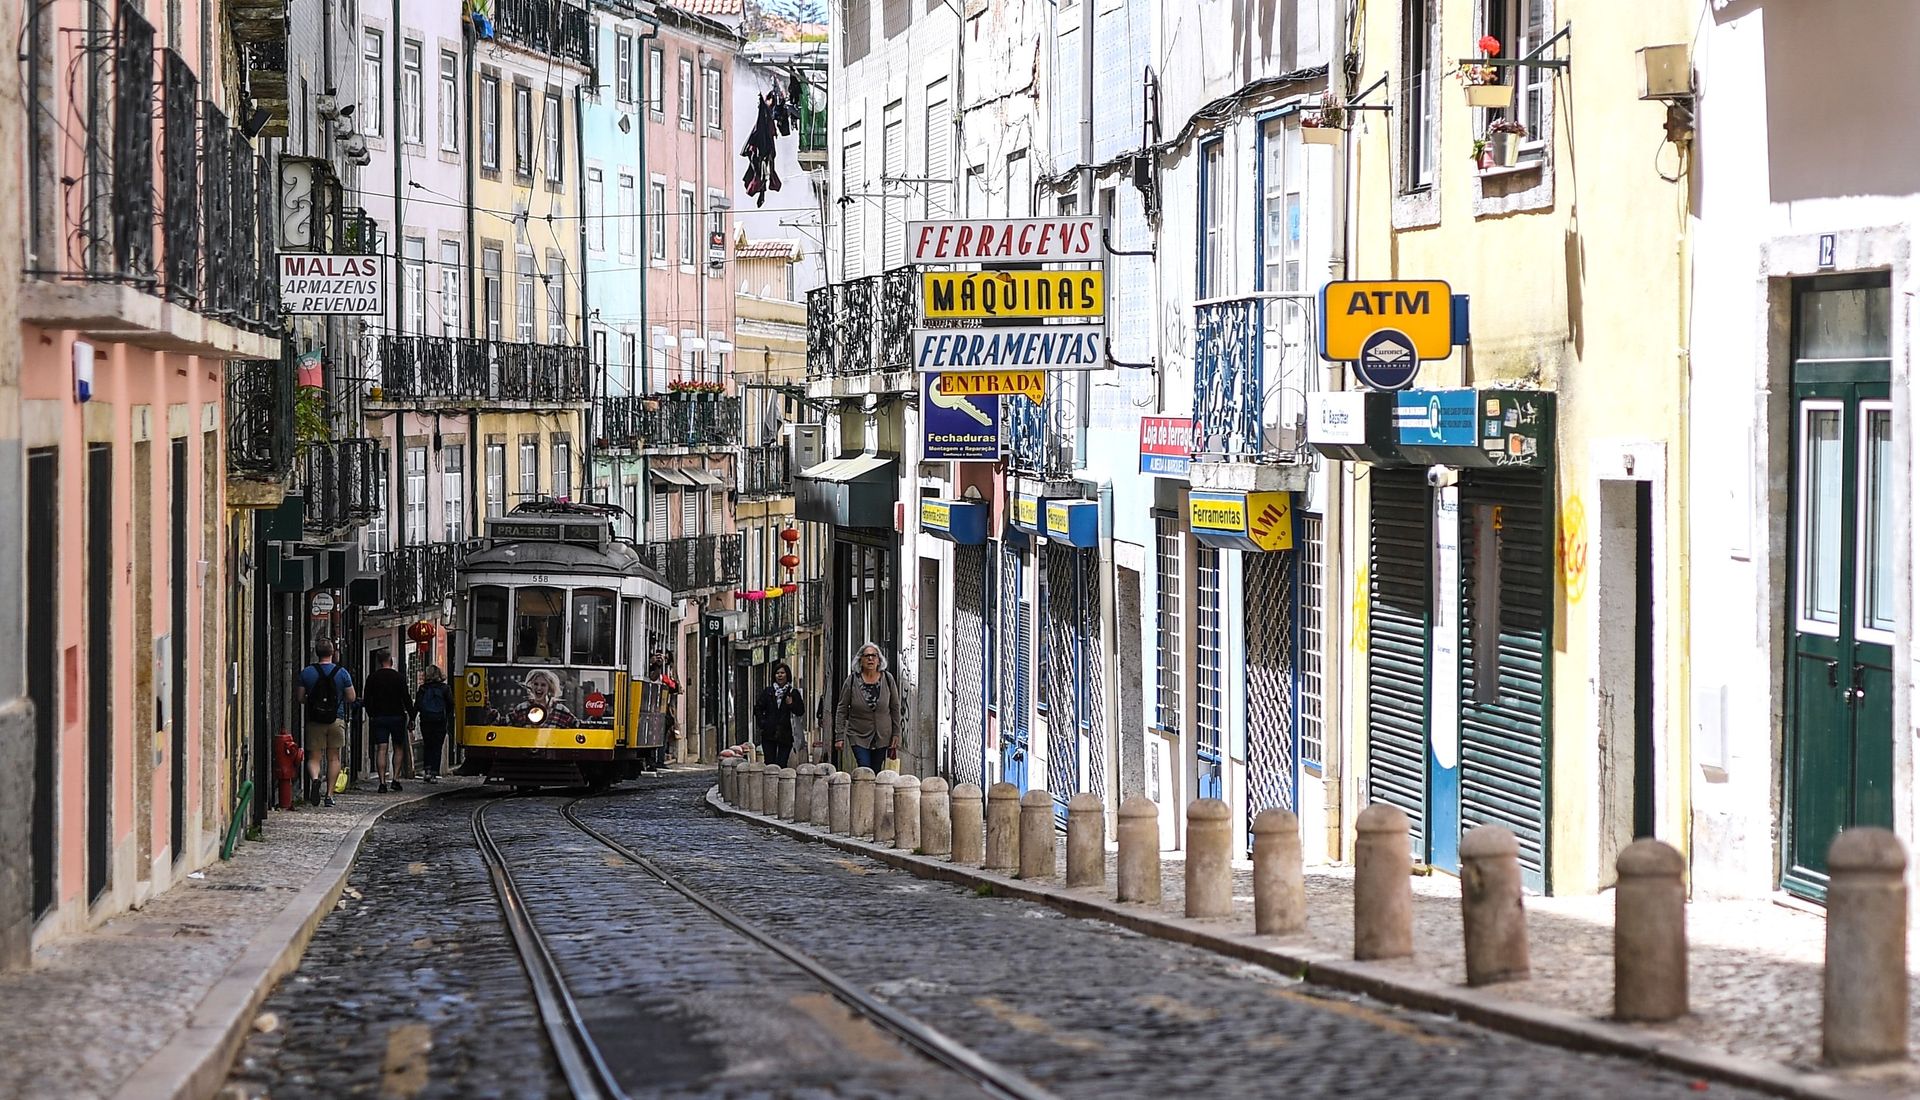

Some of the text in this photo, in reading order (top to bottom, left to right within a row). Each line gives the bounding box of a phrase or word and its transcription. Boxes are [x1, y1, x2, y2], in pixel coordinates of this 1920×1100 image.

[915, 222, 1094, 259] FERRAGENS
[1821, 236, 1833, 264] 12
[285, 257, 377, 276] MALAS
[285, 279, 377, 294] ARMAZENS
[932, 272, 1095, 314] MÁQUINAS
[302, 297, 377, 312] REVENDA
[1346, 290, 1430, 315] ATM
[918, 332, 1100, 367] FERRAMENTAS
[1374, 347, 1403, 355] Euronet
[942, 374, 1042, 393] ENTRADA
[928, 433, 996, 442] Fechaduras
[1143, 419, 1158, 450] Loja
[1158, 420, 1167, 446] de
[1193, 504, 1241, 525] Ferramentas
[1250, 503, 1289, 543] AML
[497, 526, 591, 538] PRAZERES 28
[532, 575, 549, 583] 558
[709, 620, 720, 630] 69
